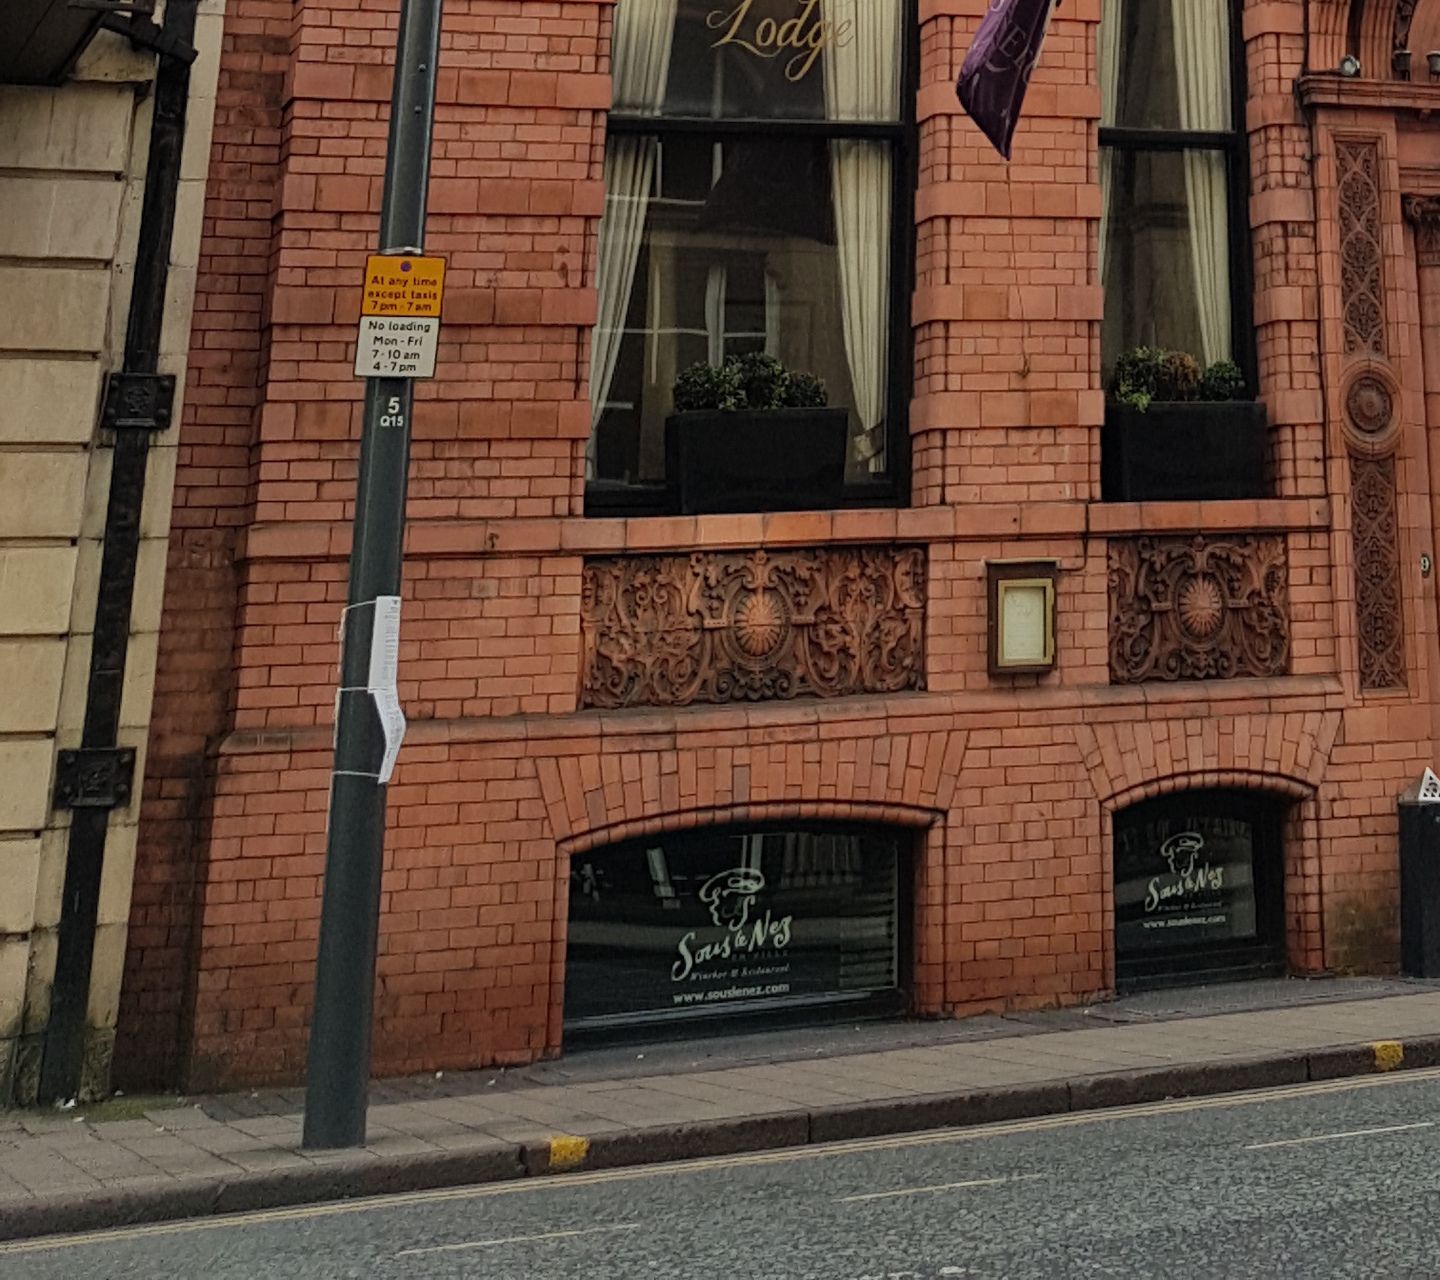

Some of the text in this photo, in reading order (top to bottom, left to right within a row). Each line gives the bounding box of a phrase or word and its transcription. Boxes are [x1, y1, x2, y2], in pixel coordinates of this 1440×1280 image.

[371, 275, 438, 288] At any time
[368, 290, 406, 300] except
[368, 320, 431, 333] No loading
[373, 335, 398, 346] Mon
[407, 336, 423, 346] Fri
[388, 396, 400, 414] 5
[380, 415, 404, 427] Q15
[671, 931, 731, 982] Sous
[748, 908, 793, 952] Nez
[672, 983, 791, 1005] www.souslenez.com
